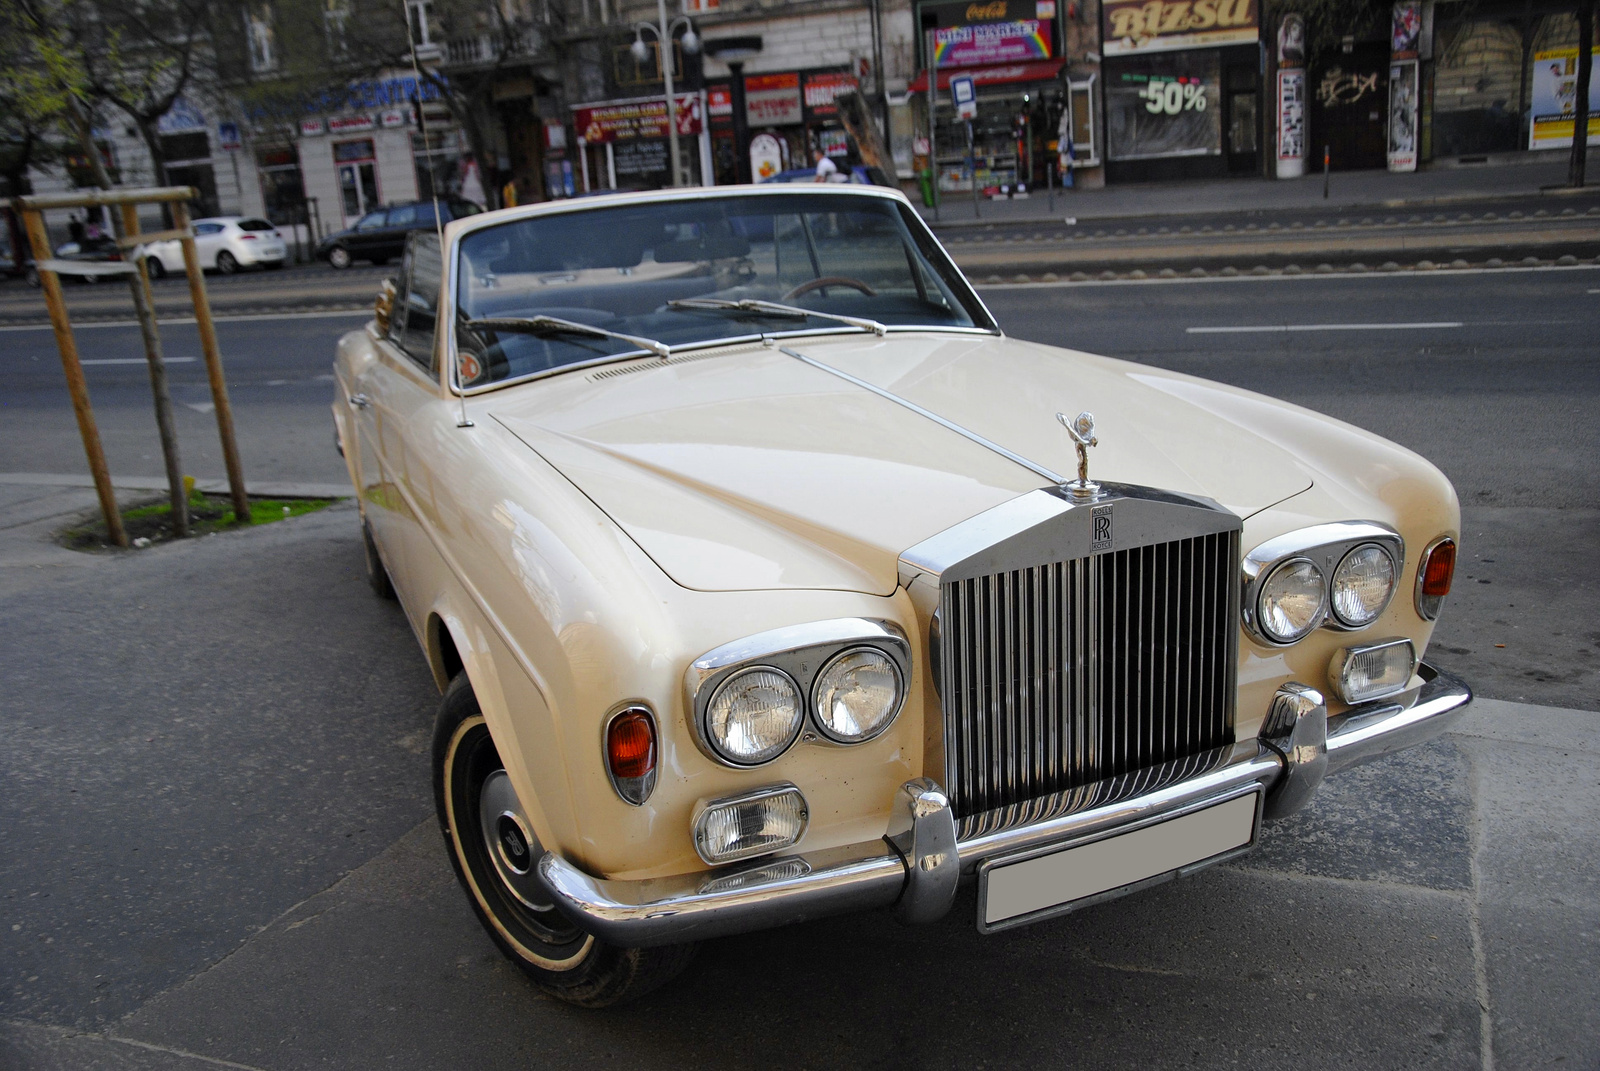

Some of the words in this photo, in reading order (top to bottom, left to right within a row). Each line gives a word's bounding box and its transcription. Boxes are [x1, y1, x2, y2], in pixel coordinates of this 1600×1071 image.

[936, 26, 972, 43] MINI
[973, 19, 1040, 40] MARKET
[1138, 80, 1207, 115] -50%
[1093, 506, 1112, 515] ROLLS
[1093, 542, 1111, 550] ROYCE
